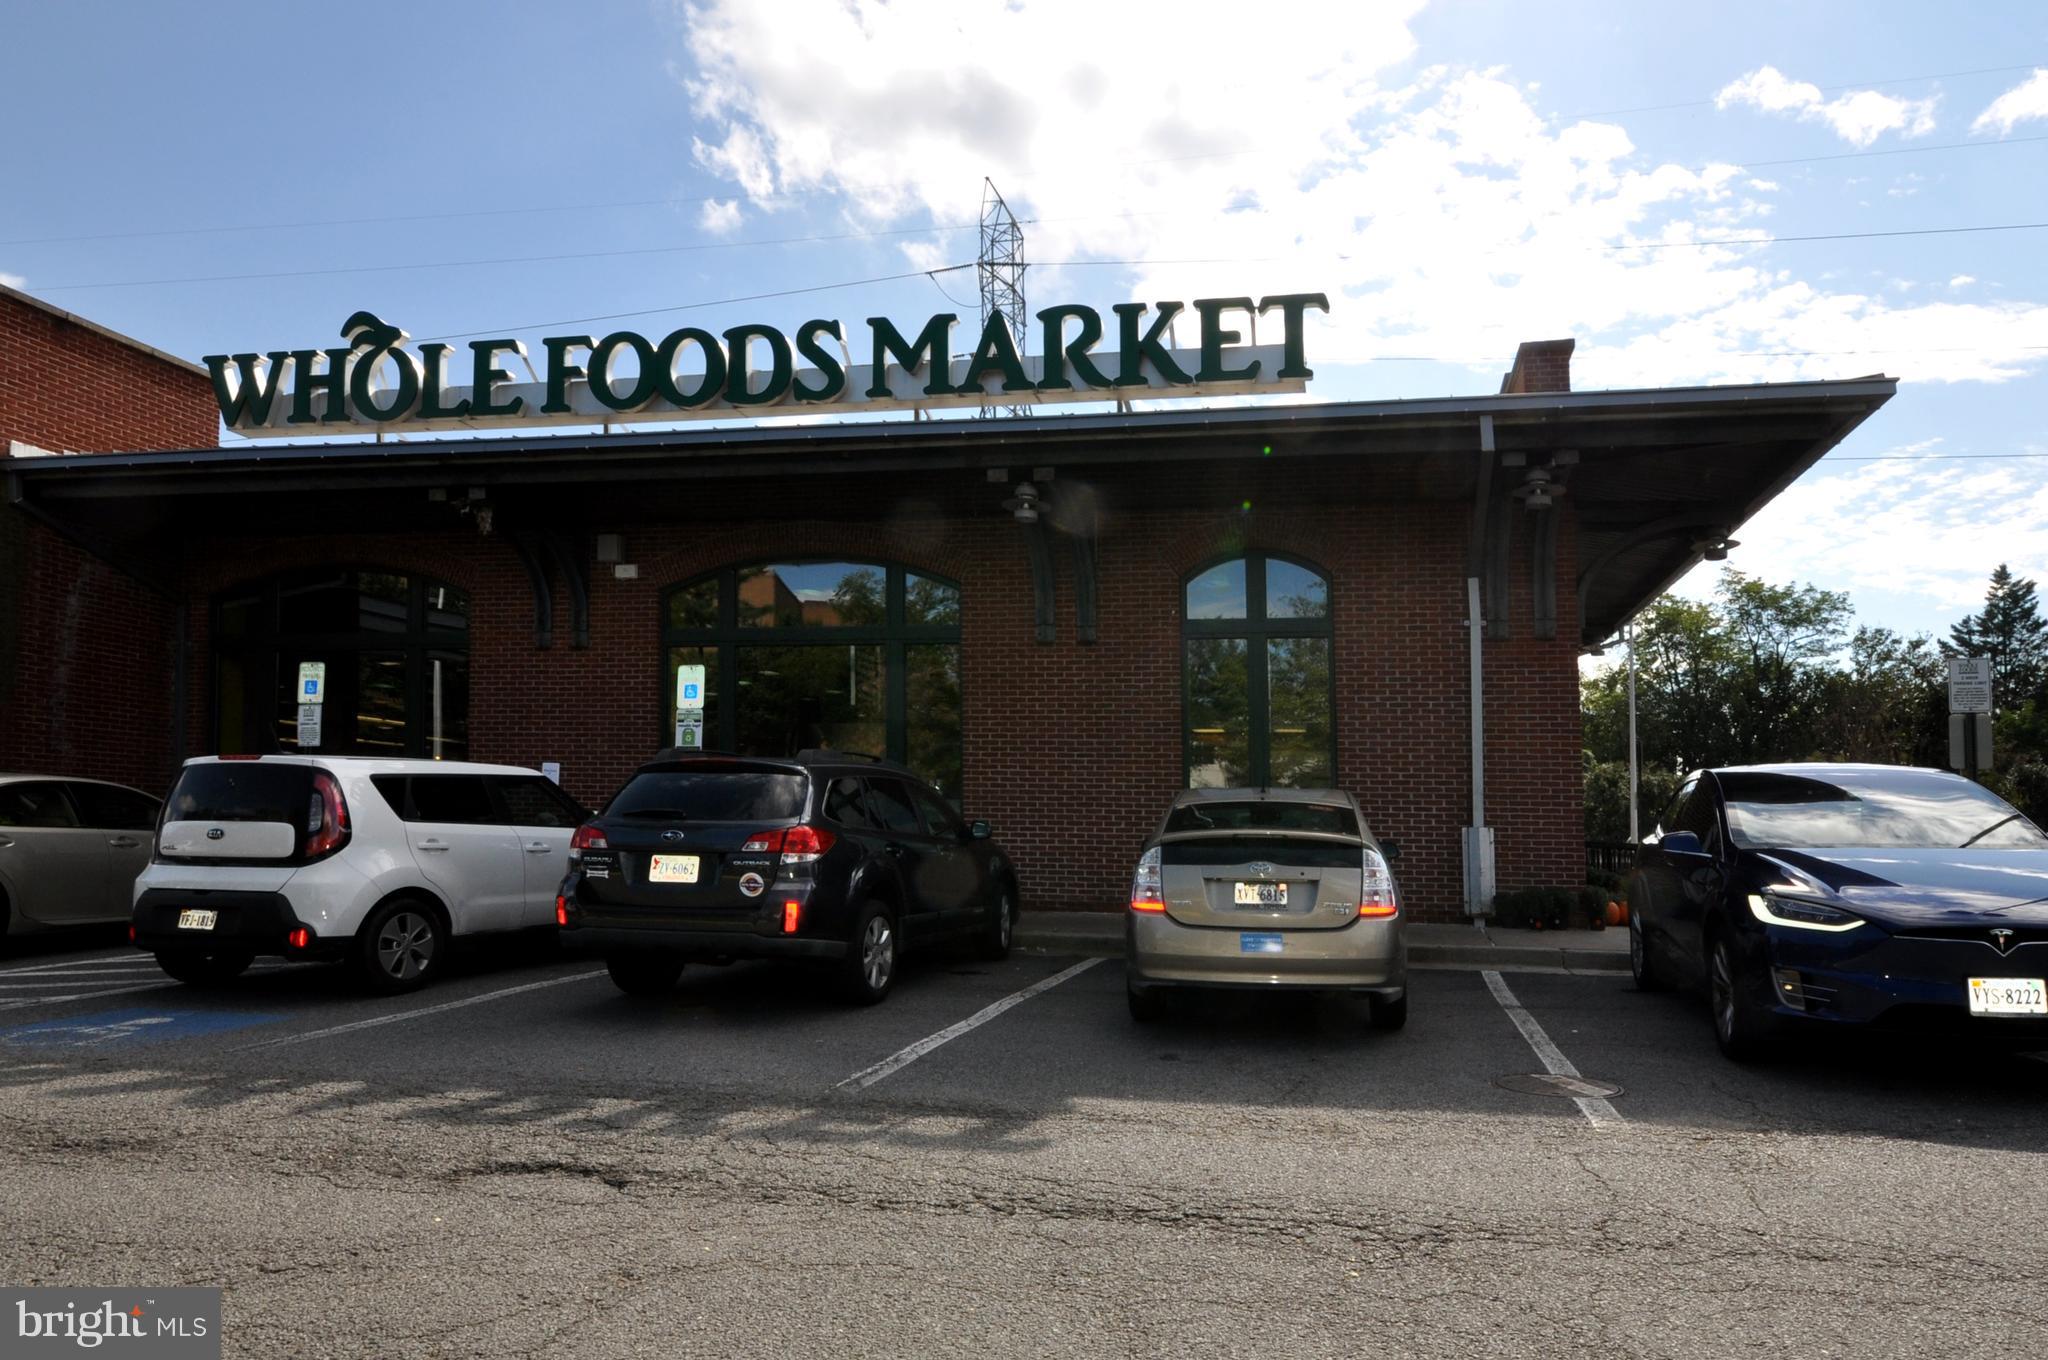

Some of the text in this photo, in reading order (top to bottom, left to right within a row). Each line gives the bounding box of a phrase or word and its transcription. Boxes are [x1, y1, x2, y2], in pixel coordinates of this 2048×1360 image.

[202, 292, 1330, 427] WHOLE FOODS MARKET
[1973, 987, 2041, 1005] VYS-8222
